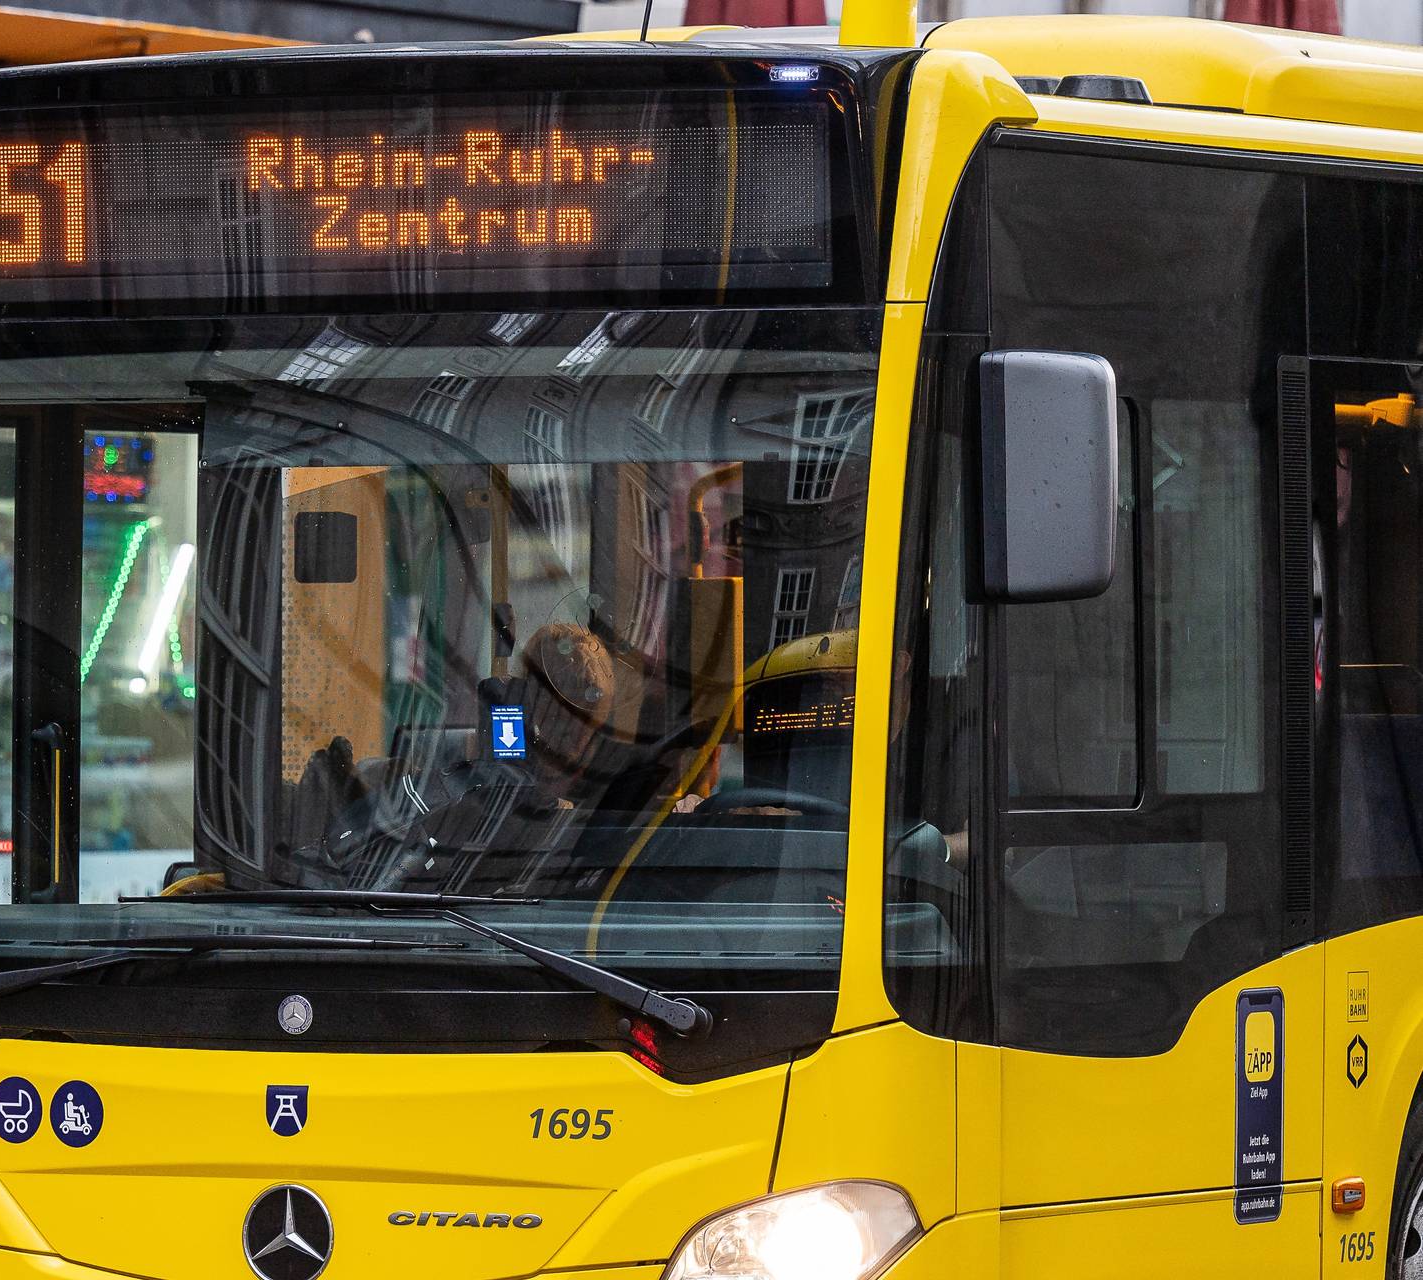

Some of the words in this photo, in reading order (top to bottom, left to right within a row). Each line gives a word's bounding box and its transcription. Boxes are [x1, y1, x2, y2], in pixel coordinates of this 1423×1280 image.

[249, 130, 655, 190] Rhein-Ruhr-
[313, 196, 594, 248] Zentrum
[1349, 988, 1367, 1001] RUHR
[1349, 1004, 1367, 1016] BAHN
[1247, 1047, 1272, 1074] ZÄPP
[1351, 1056, 1364, 1067] VRR
[1250, 1086, 1259, 1099] Ziel
[1259, 1086, 1269, 1100] App
[529, 1108, 614, 1140] 1695
[1249, 1136, 1261, 1147] Jetzt
[1262, 1134, 1270, 1145] die
[1242, 1151, 1266, 1164] Ruhrbahn
[1266, 1151, 1276, 1164] App
[1251, 1168, 1267, 1180] laden!
[1241, 1196, 1275, 1213] app.ruhrbahn.de
[387, 1211, 543, 1229] CITARO
[1339, 1231, 1376, 1263] 1695
